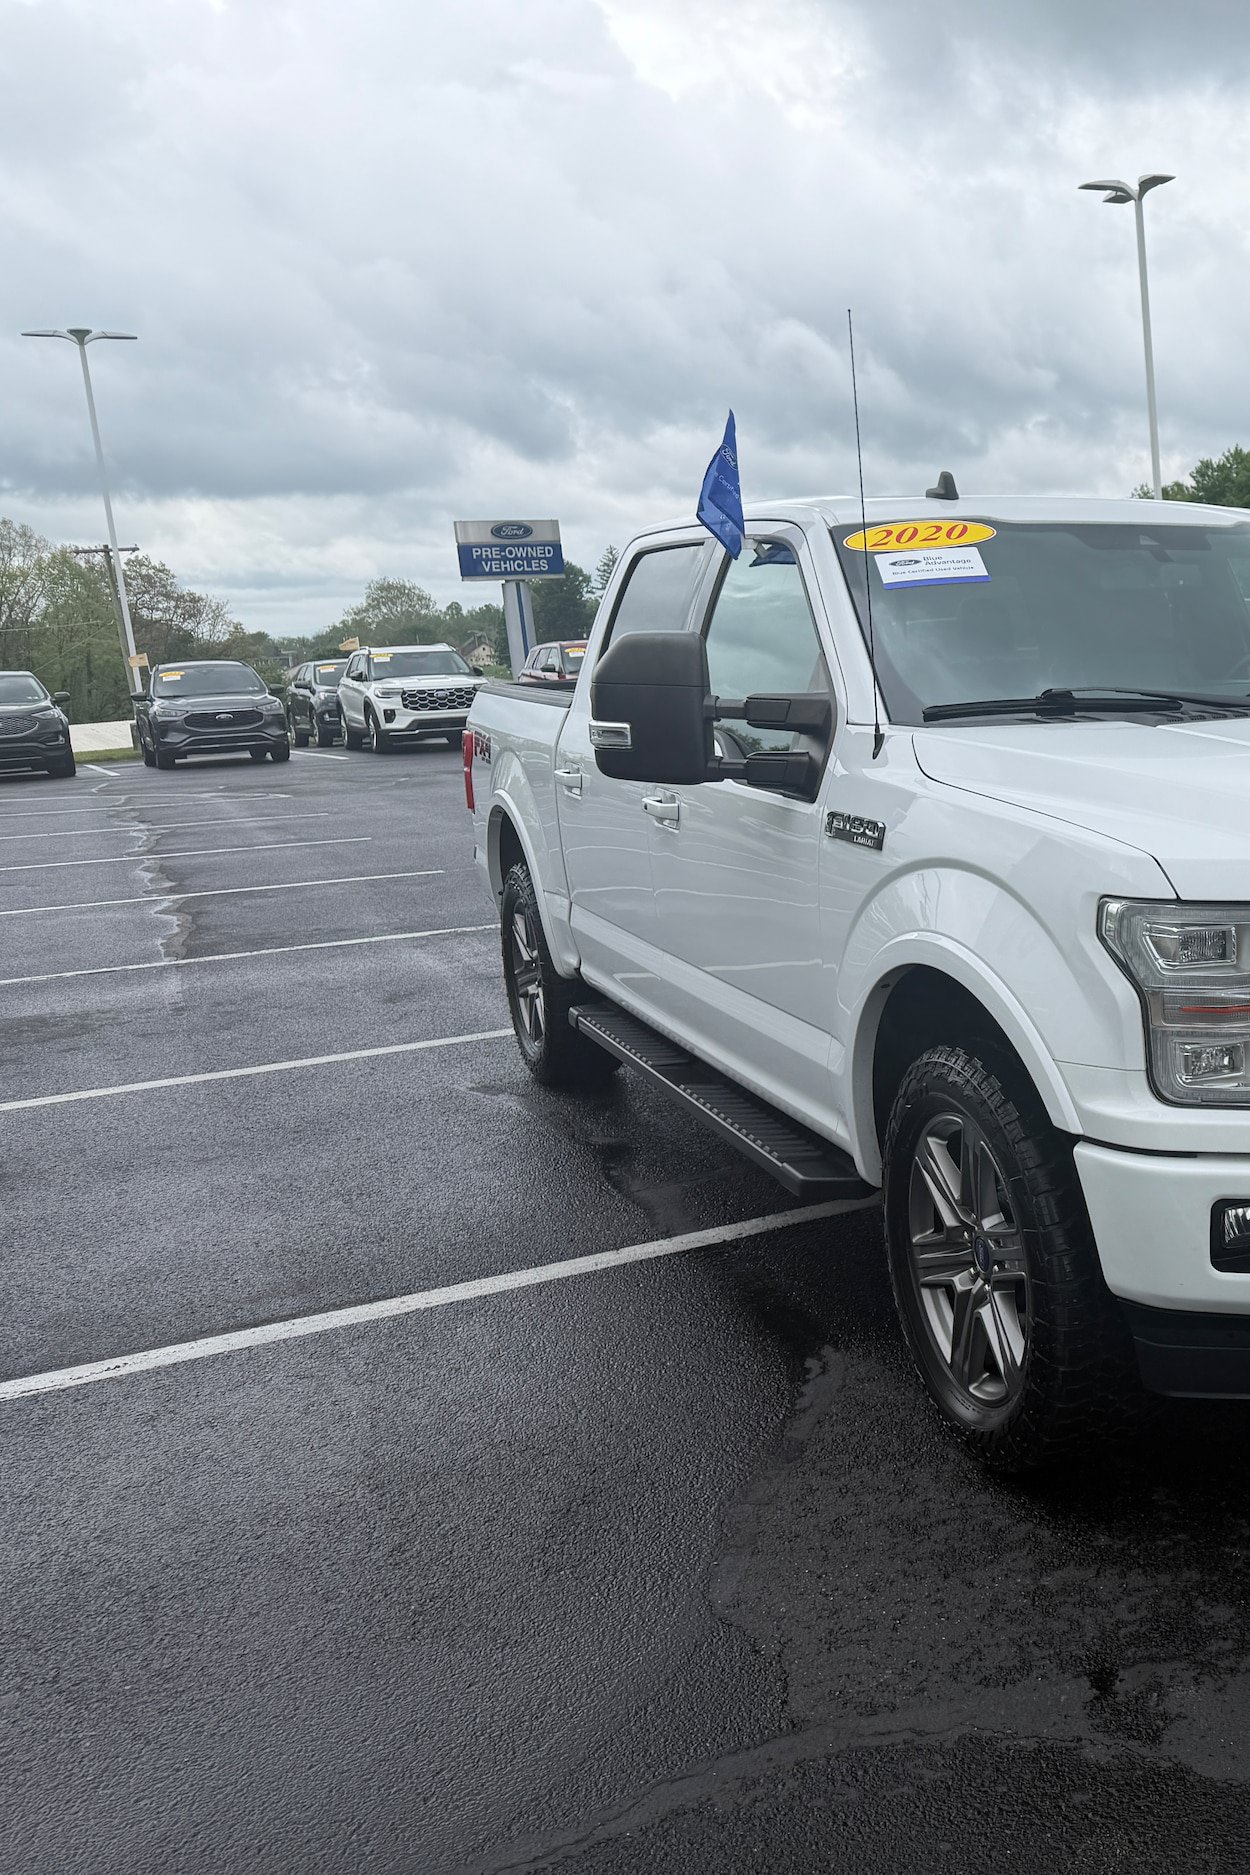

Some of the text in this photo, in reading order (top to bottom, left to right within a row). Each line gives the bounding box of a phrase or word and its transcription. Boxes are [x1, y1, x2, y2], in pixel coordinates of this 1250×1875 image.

[500, 525, 524, 536] Ford
[869, 523, 968, 547] 2020
[472, 546, 554, 559] PRE-OWNED
[482, 559, 549, 572] VEHICLES
[474, 730, 492, 760] FX4
